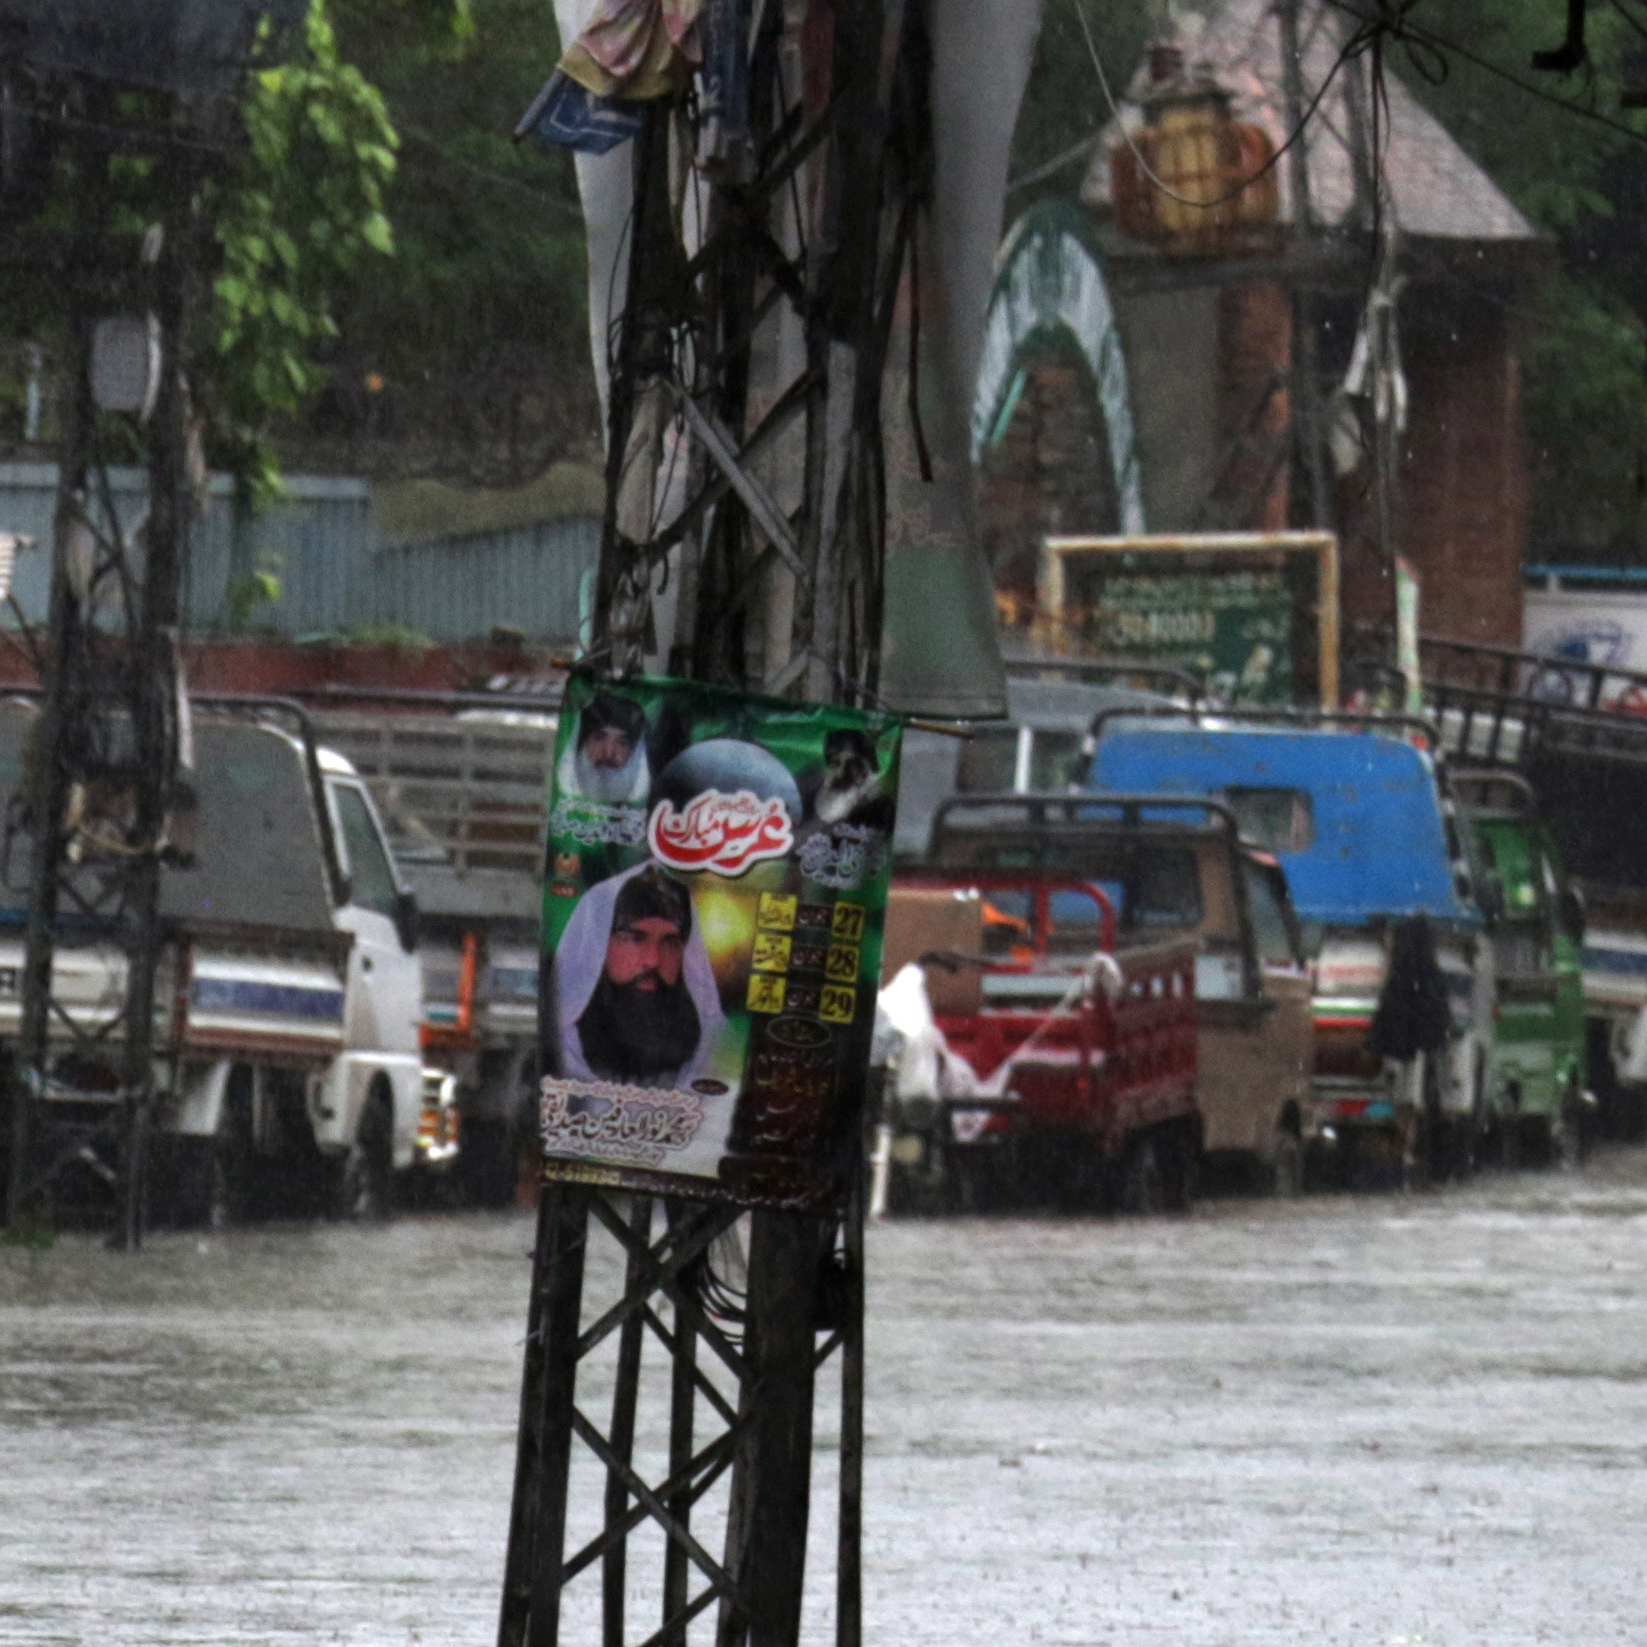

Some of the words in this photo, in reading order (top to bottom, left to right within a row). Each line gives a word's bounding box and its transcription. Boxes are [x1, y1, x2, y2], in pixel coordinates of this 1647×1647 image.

[832, 905, 862, 936] 27
[827, 947, 856, 978] 28
[821, 988, 851, 1018] 29
